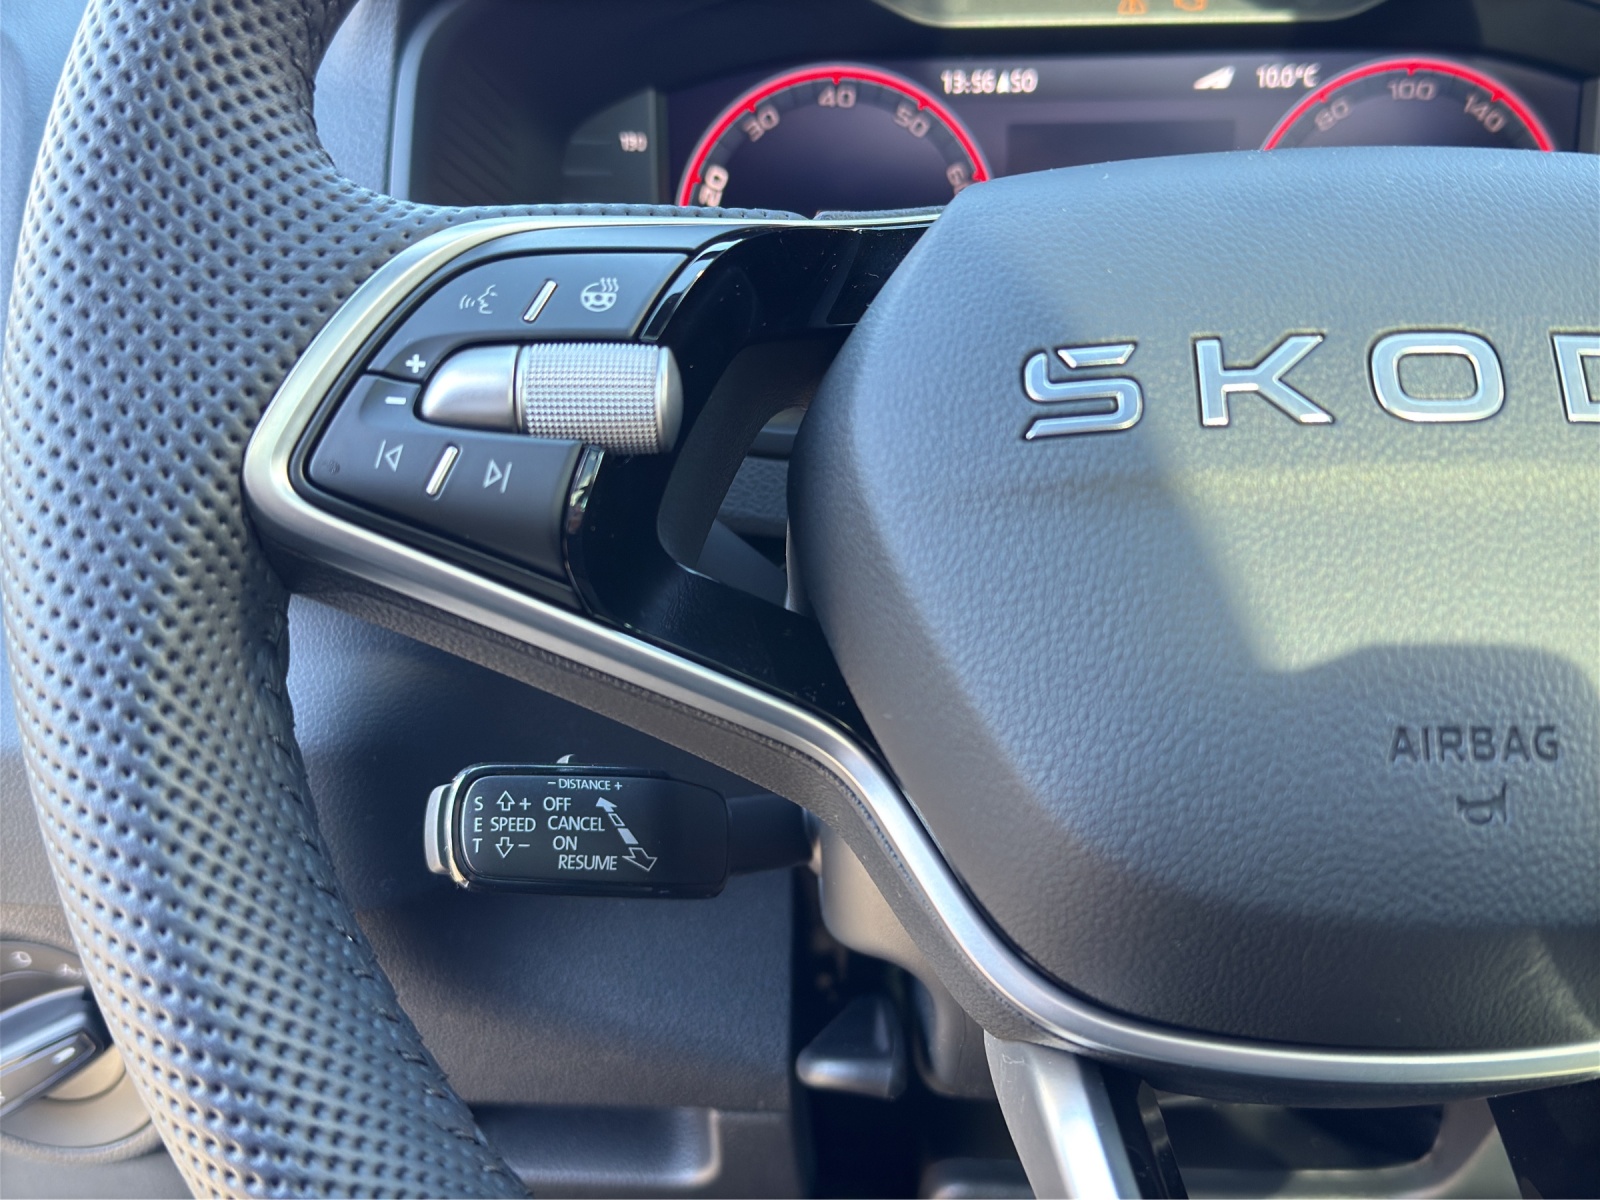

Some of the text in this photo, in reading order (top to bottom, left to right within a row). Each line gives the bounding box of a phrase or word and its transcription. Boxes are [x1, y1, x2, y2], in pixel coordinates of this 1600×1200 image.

[940, 68, 997, 95] 13:56
[1387, 79, 1436, 101] 100
[817, 85, 857, 109] 40
[743, 104, 780, 142] 30
[896, 104, 931, 138] 50
[1315, 96, 1352, 132] 80
[1463, 92, 1506, 133] 140
[946, 163, 970, 195] 6
[1388, 724, 1560, 765] AIRBAG
[558, 778, 611, 791] DISTANCE
[543, 796, 572, 811] OFF
[490, 816, 536, 833] SPEED
[547, 815, 605, 832] CANCEL
[552, 836, 578, 851] ON
[557, 854, 618, 871] RESUME
